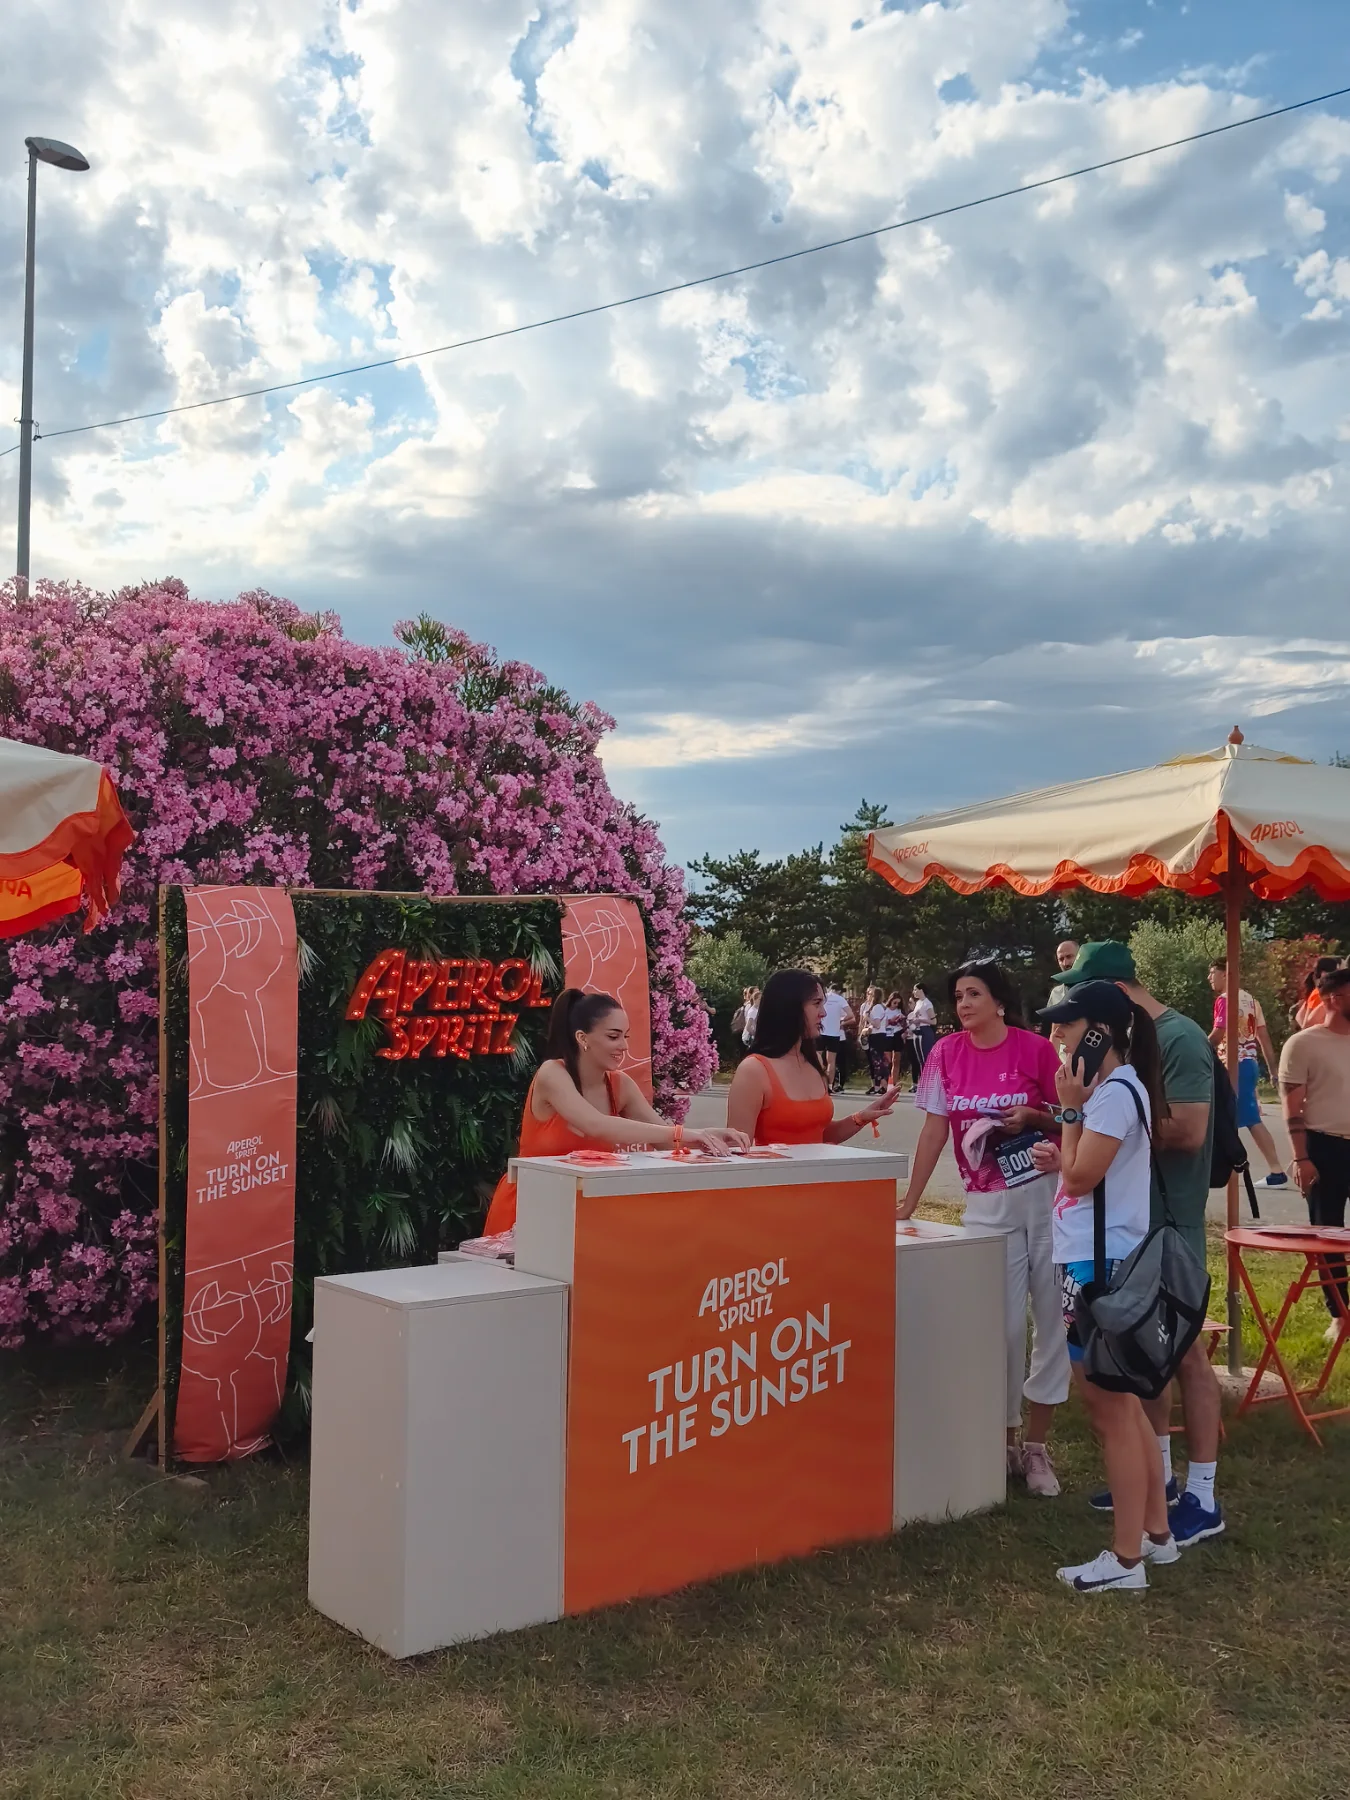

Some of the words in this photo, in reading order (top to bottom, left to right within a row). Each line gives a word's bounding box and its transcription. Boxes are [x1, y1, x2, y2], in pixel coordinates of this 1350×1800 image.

[1251, 820, 1304, 843] APEROL
[893, 841, 929, 863] APEROL
[345, 948, 552, 1021] APEROL
[951, 1092, 1029, 1111] Telekom
[226, 1135, 263, 1154] APEROL
[234, 1147, 257, 1159] SPRITZ
[196, 1182, 227, 1204] THE
[231, 1164, 288, 1195] SUNSET
[206, 1160, 251, 1185] TURN
[255, 1151, 279, 1171] ON
[698, 1257, 790, 1317] APEROL
[719, 1292, 773, 1332] SPRITZ
[648, 1332, 757, 1413] TURN
[770, 1303, 830, 1361] ON
[622, 1404, 698, 1474] THE
[710, 1340, 851, 1437] SUNSET
